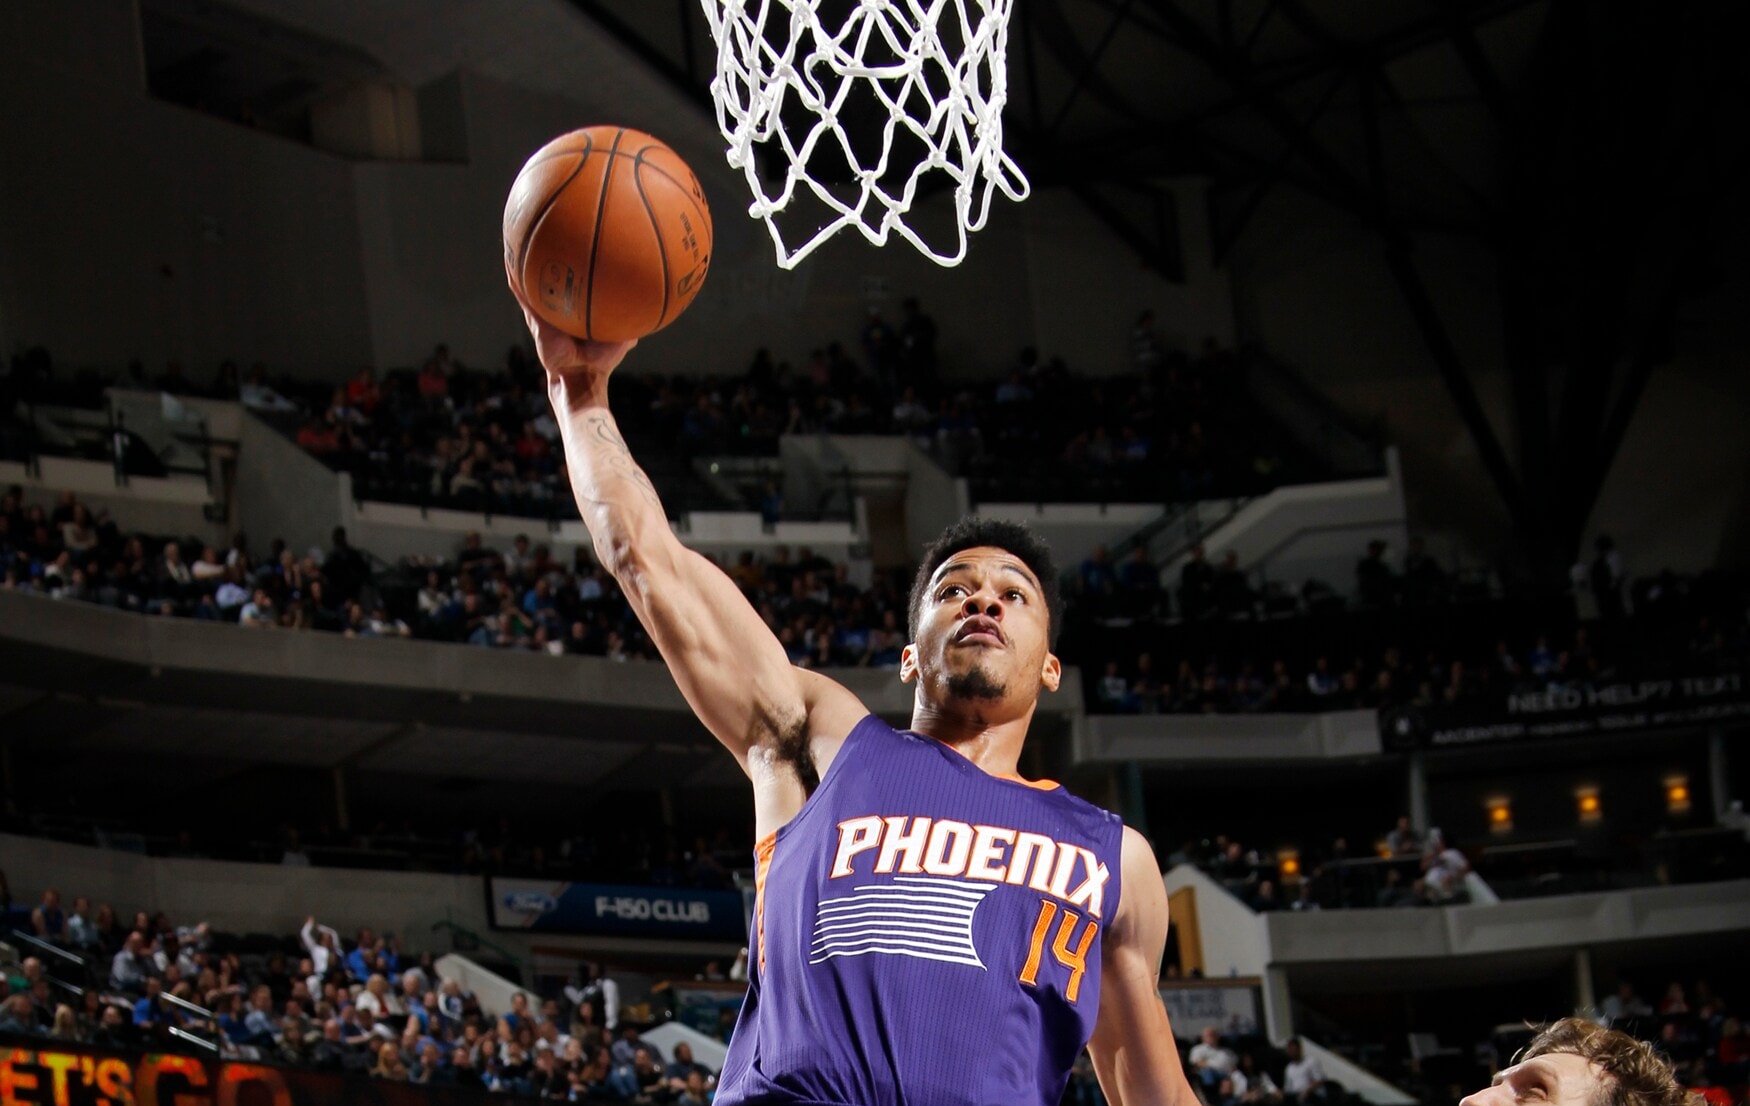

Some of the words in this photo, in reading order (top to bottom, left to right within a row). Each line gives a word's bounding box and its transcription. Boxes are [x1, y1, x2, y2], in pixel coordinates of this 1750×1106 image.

[1508, 688, 1583, 713] NEED
[1587, 680, 1673, 707] HELP?
[1680, 673, 1742, 696] TEXT
[829, 815, 1110, 919] PHOENIX
[595, 896, 650, 920] F-150
[652, 899, 710, 923] CLUB
[1019, 899, 1098, 1004] 14
